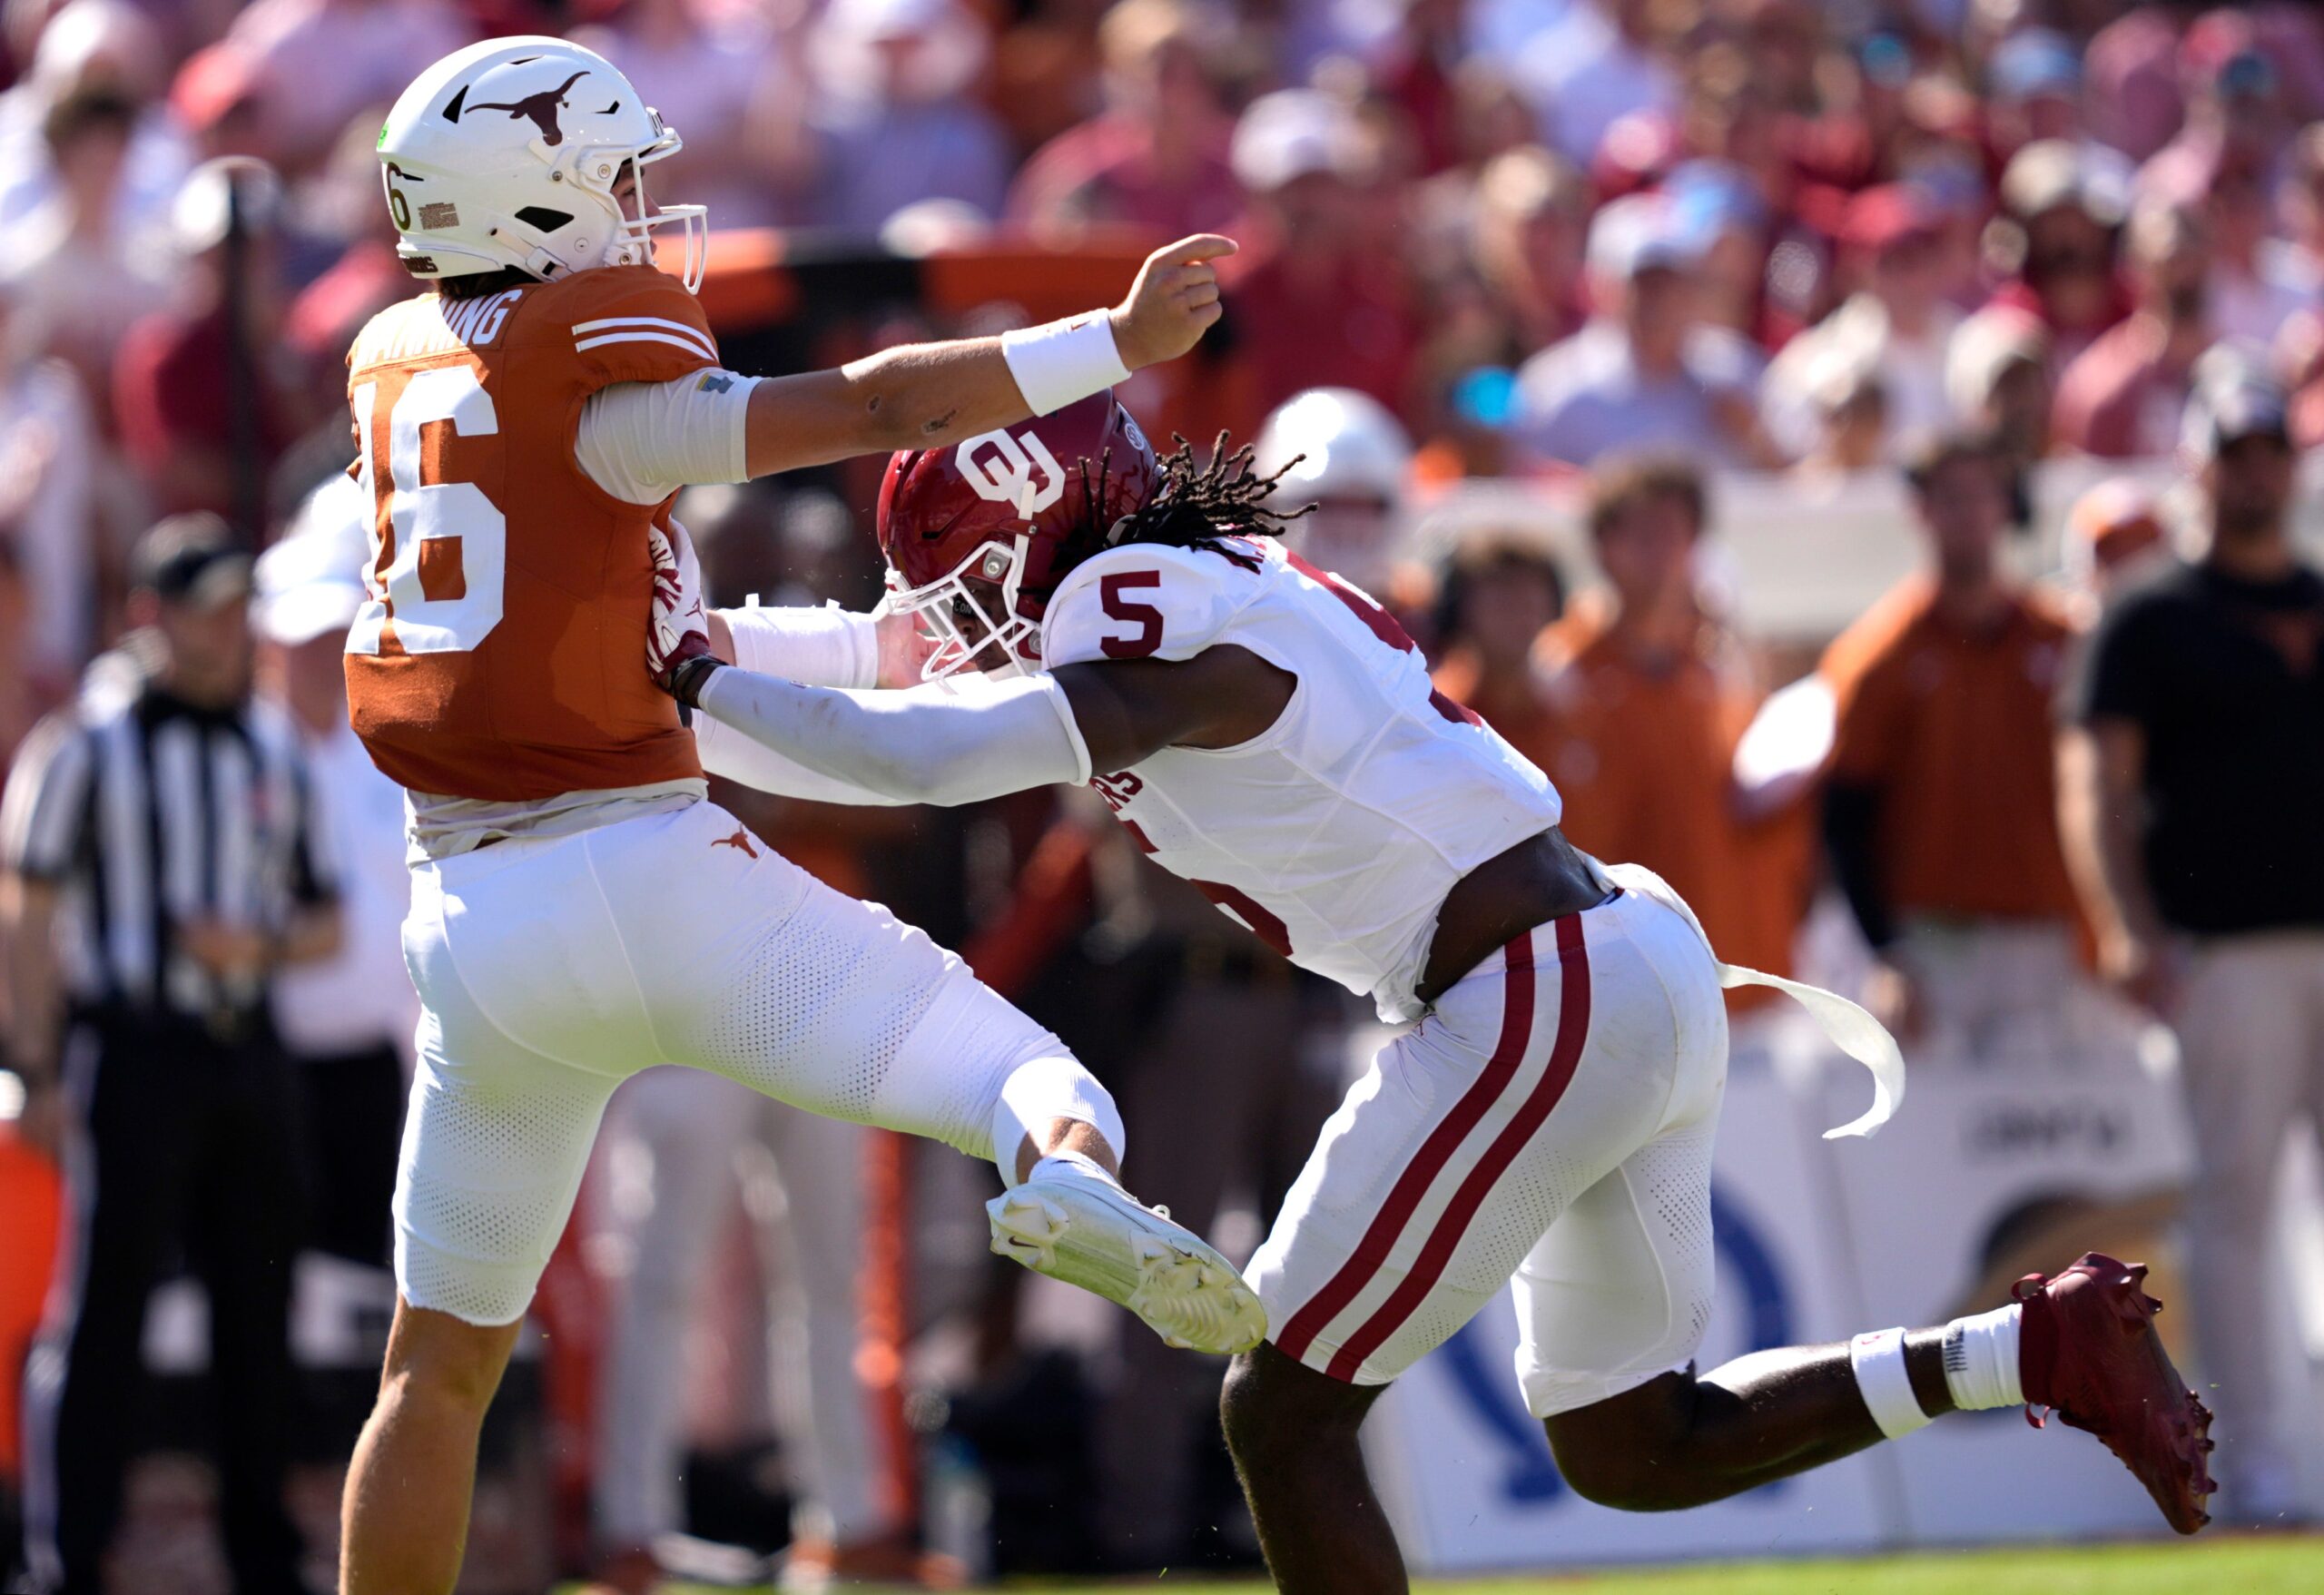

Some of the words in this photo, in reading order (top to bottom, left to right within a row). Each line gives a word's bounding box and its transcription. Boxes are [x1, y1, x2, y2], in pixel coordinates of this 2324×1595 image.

[344, 365, 506, 655] 16
[955, 428, 1066, 514] OU
[1100, 570, 1164, 660] 5
